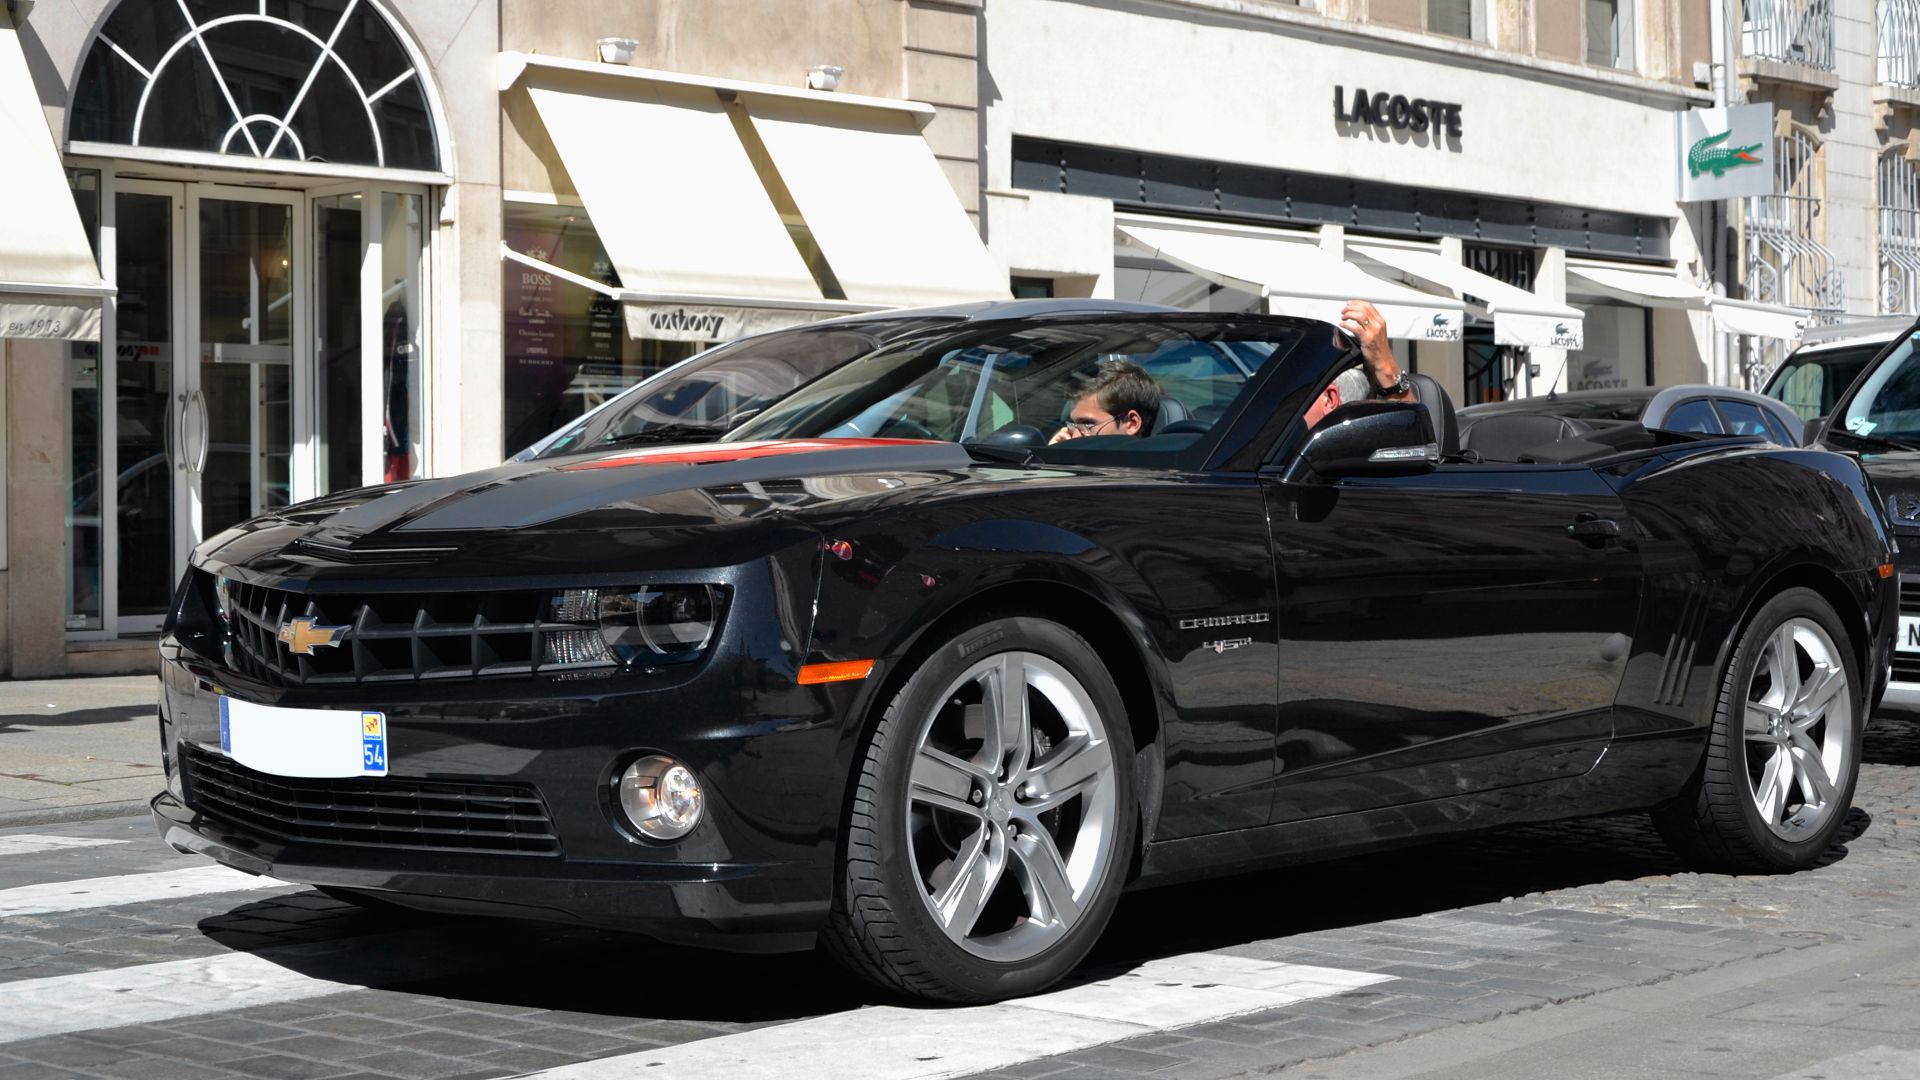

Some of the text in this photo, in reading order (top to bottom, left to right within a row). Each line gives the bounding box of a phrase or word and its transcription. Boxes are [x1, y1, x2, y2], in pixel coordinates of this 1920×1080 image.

[1334, 85, 1463, 138] LACOSTE
[522, 272, 552, 286] BOSS
[1426, 328, 1458, 340] LACOSTE
[1180, 612, 1270, 630] CAMARO
[364, 744, 383, 766] 54
